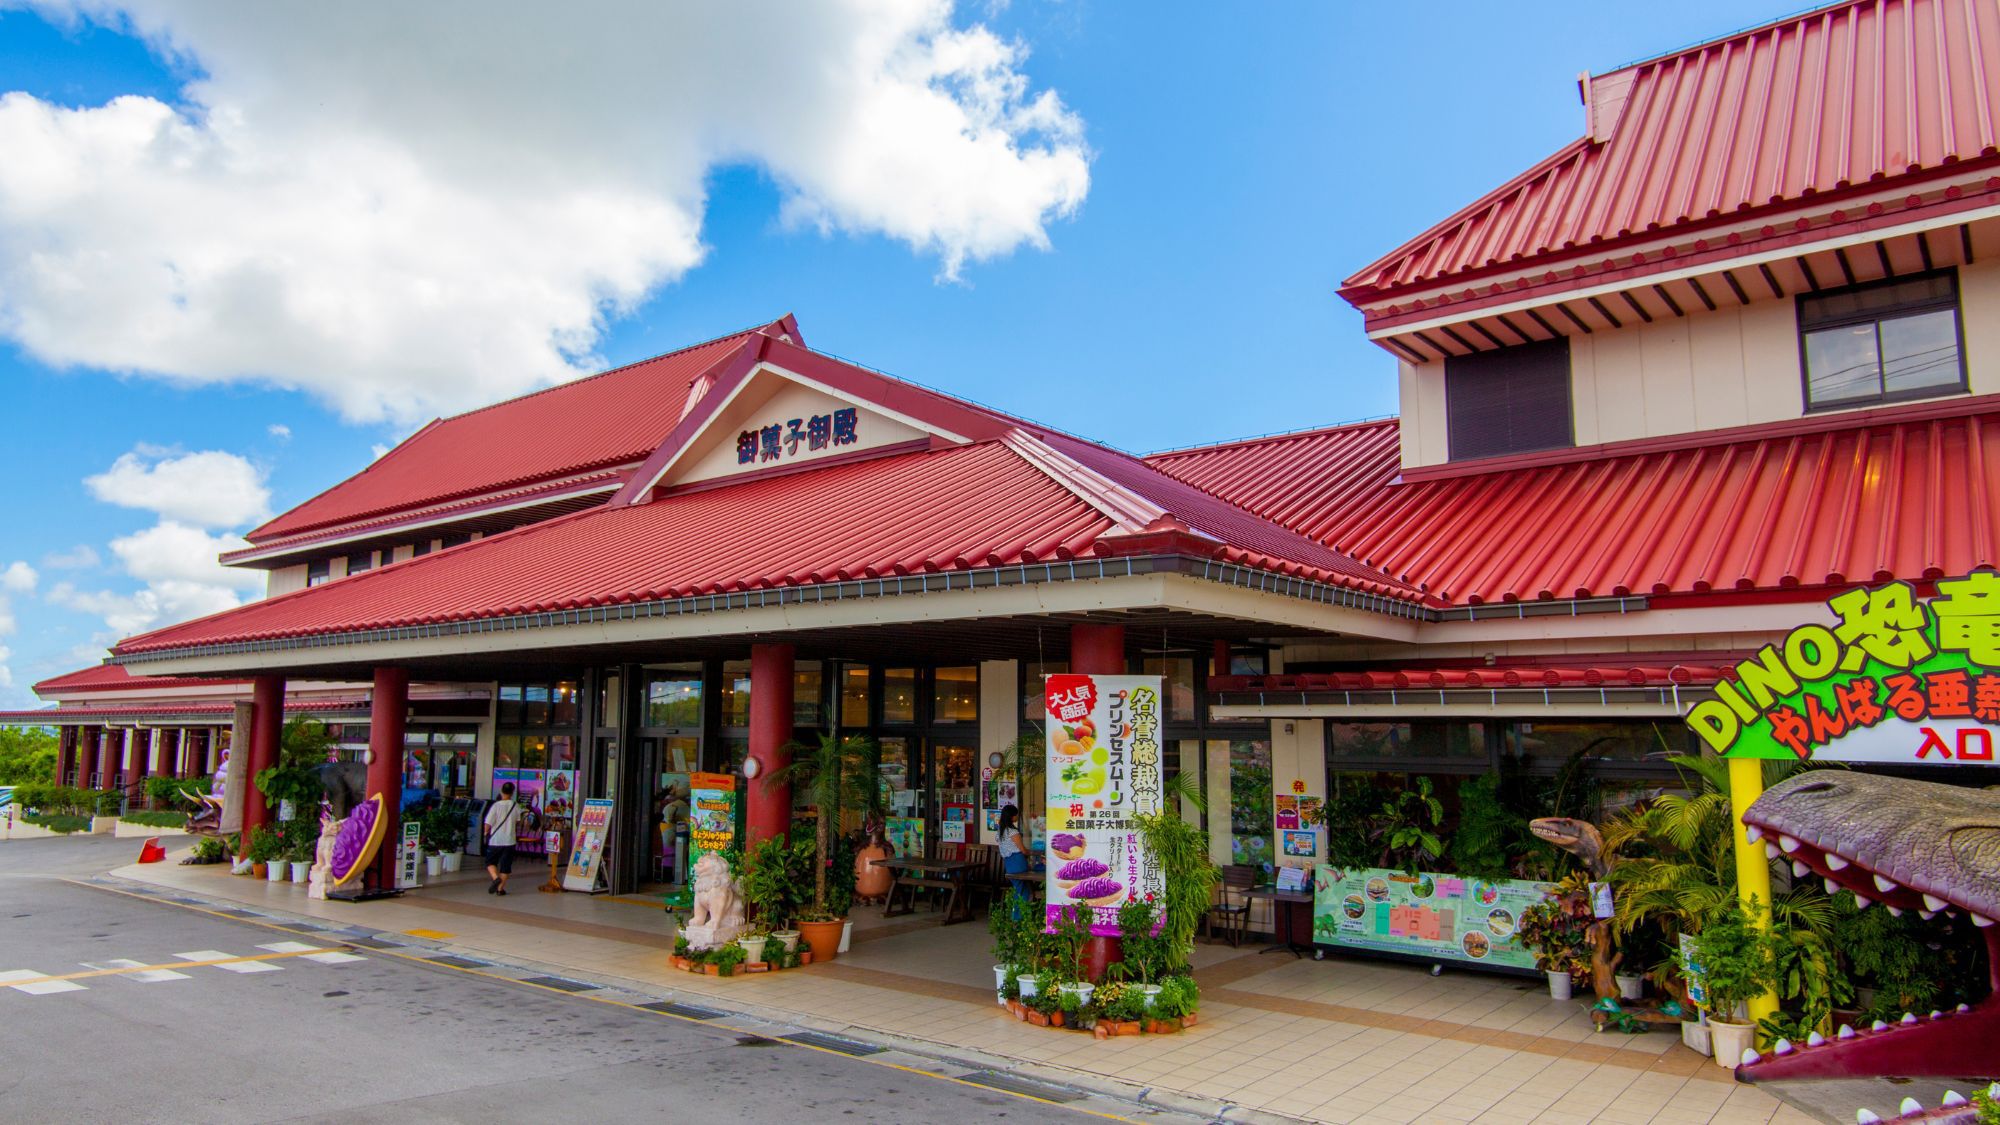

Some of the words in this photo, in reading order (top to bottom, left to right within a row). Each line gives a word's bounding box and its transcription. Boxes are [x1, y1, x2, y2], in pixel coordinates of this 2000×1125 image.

[736, 407, 858, 465] 御菓子御殿
[1049, 686, 1091, 708] 大人気
[1060, 702, 1089, 721] 商品
[1109, 690, 1128, 806] プリンセスムーン
[1131, 688, 1159, 817] 名誉総裁賞
[1915, 726, 1993, 760] 入口
[1065, 819, 1140, 830] 全国菓子大博覧
[1070, 803, 1084, 818] 祝
[1127, 833, 1138, 897] 紅いも生タル
